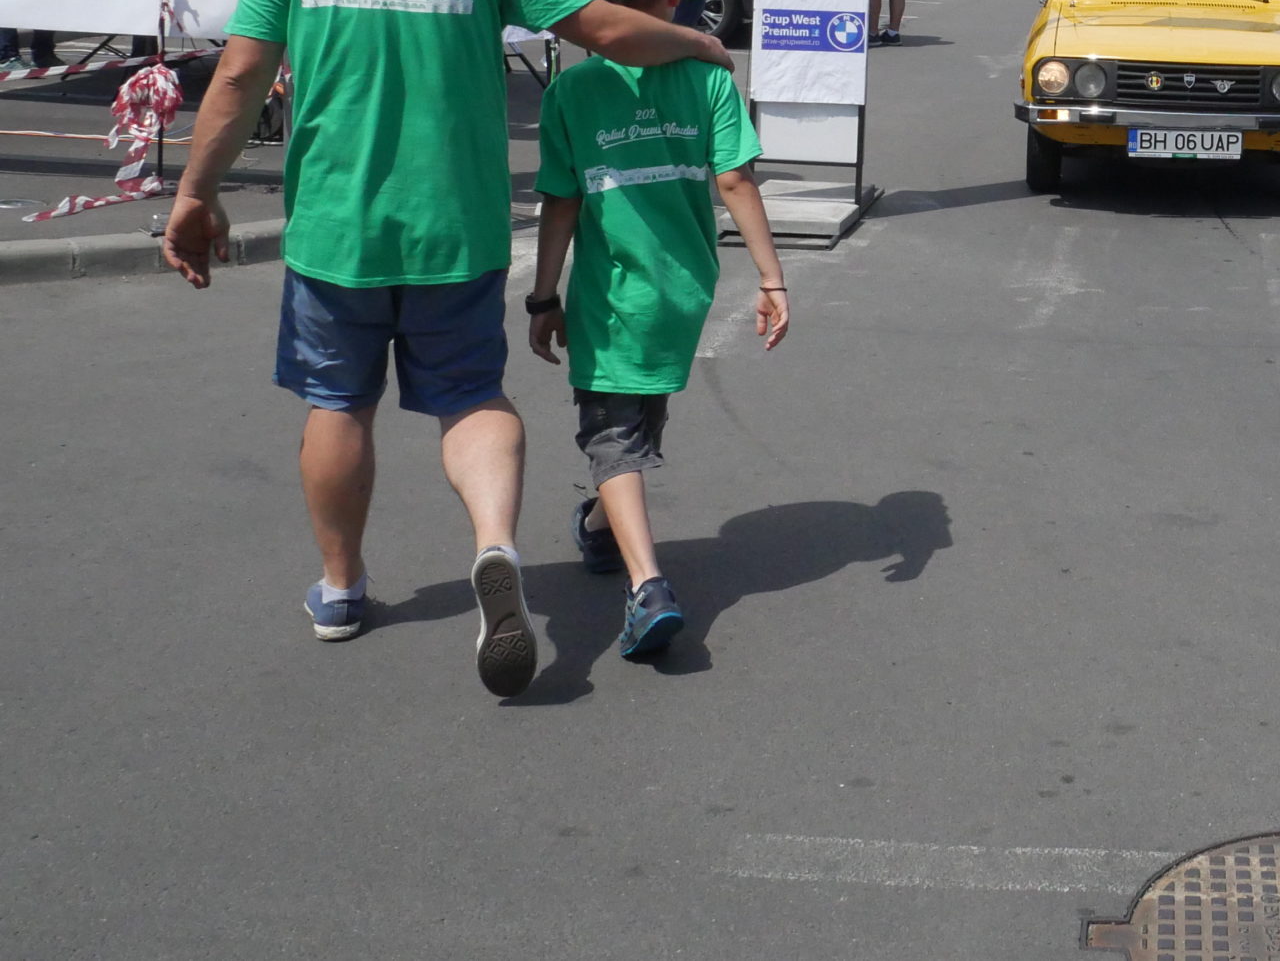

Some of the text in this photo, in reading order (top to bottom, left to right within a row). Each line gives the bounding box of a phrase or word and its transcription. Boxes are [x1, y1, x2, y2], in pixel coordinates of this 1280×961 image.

[762, 14, 820, 25] Grup West
[762, 26, 809, 37] Premium
[1140, 132, 1239, 151] BH 06 UAP
